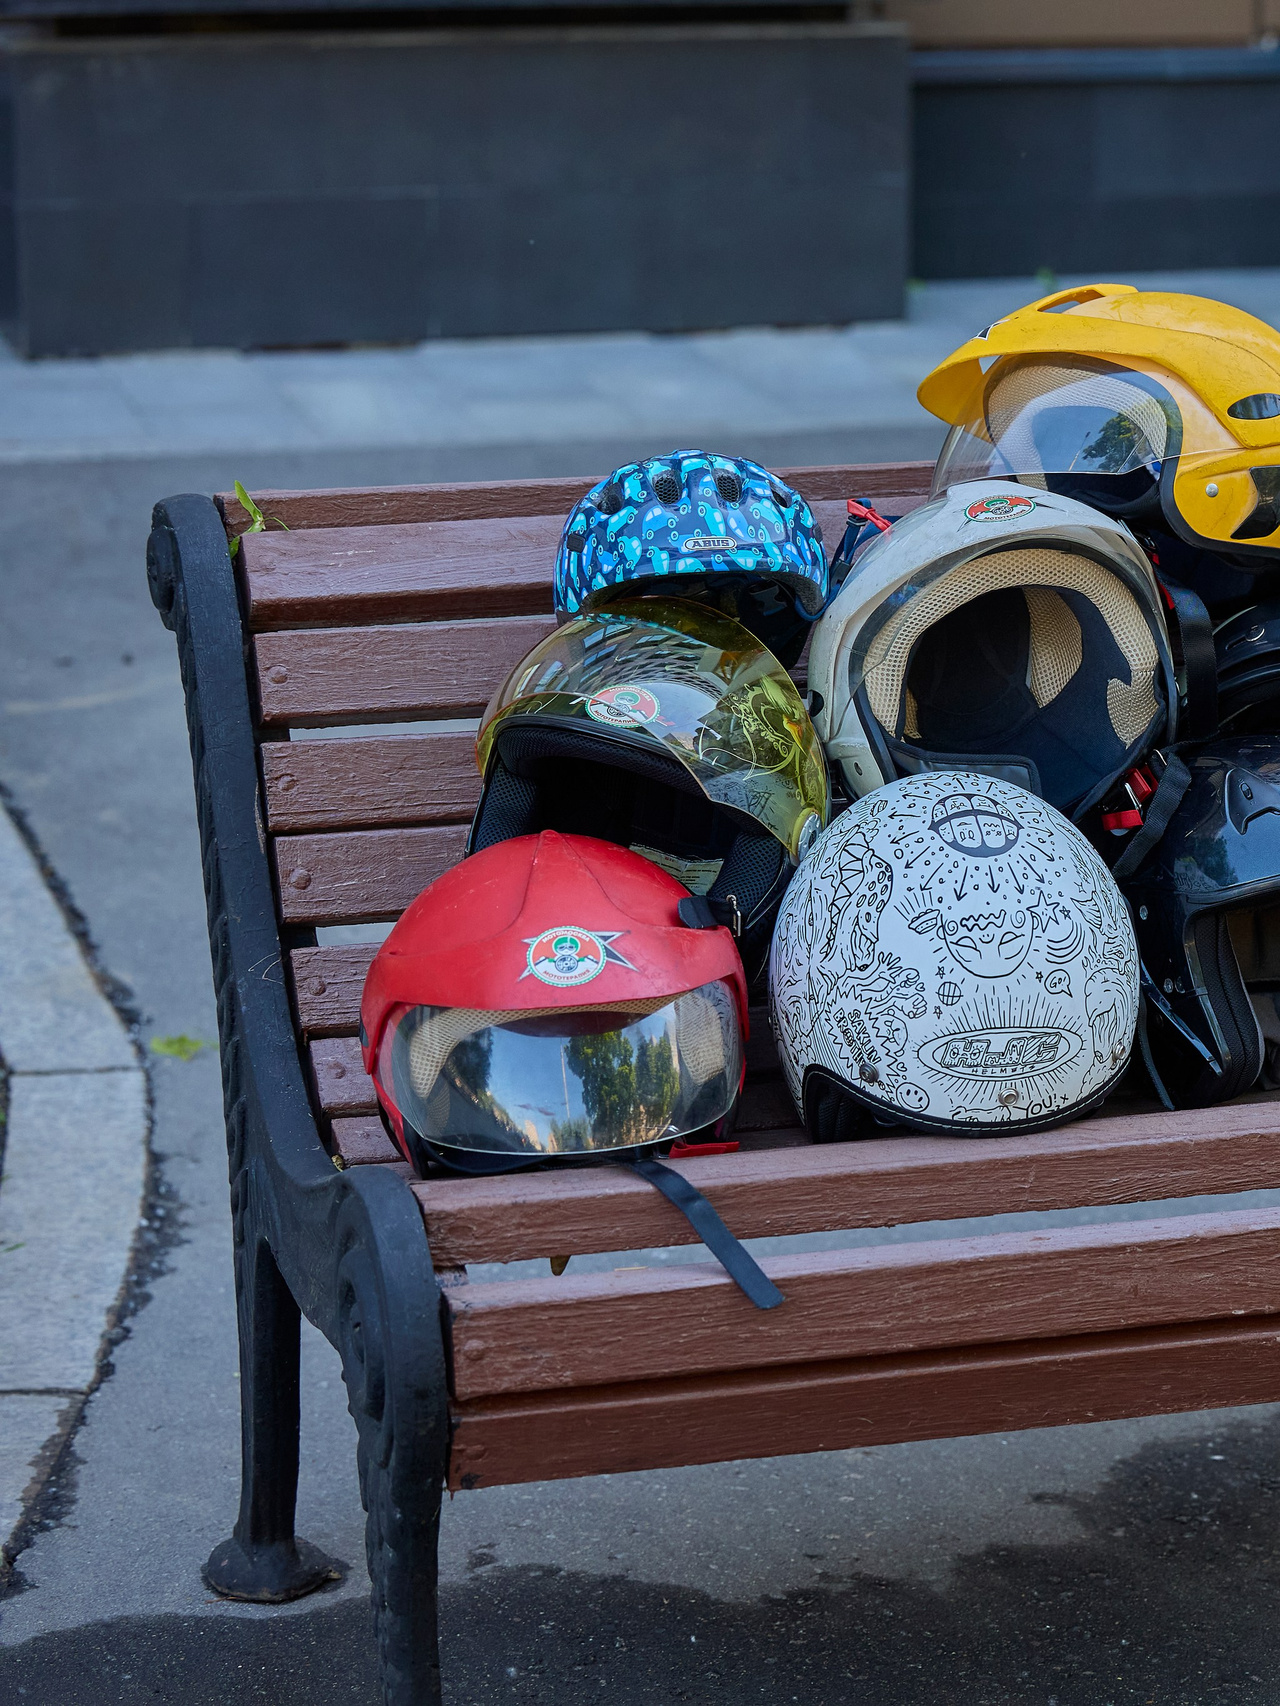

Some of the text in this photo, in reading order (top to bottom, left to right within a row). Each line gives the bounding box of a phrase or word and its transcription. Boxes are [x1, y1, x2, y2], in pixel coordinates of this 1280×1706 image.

[692, 540, 730, 548] ABUS
[542, 930, 590, 943] МОТОМОСКВА
[543, 969, 591, 981] МОТОТЕРАПИЯ
[940, 1032, 1062, 1068] HJC
